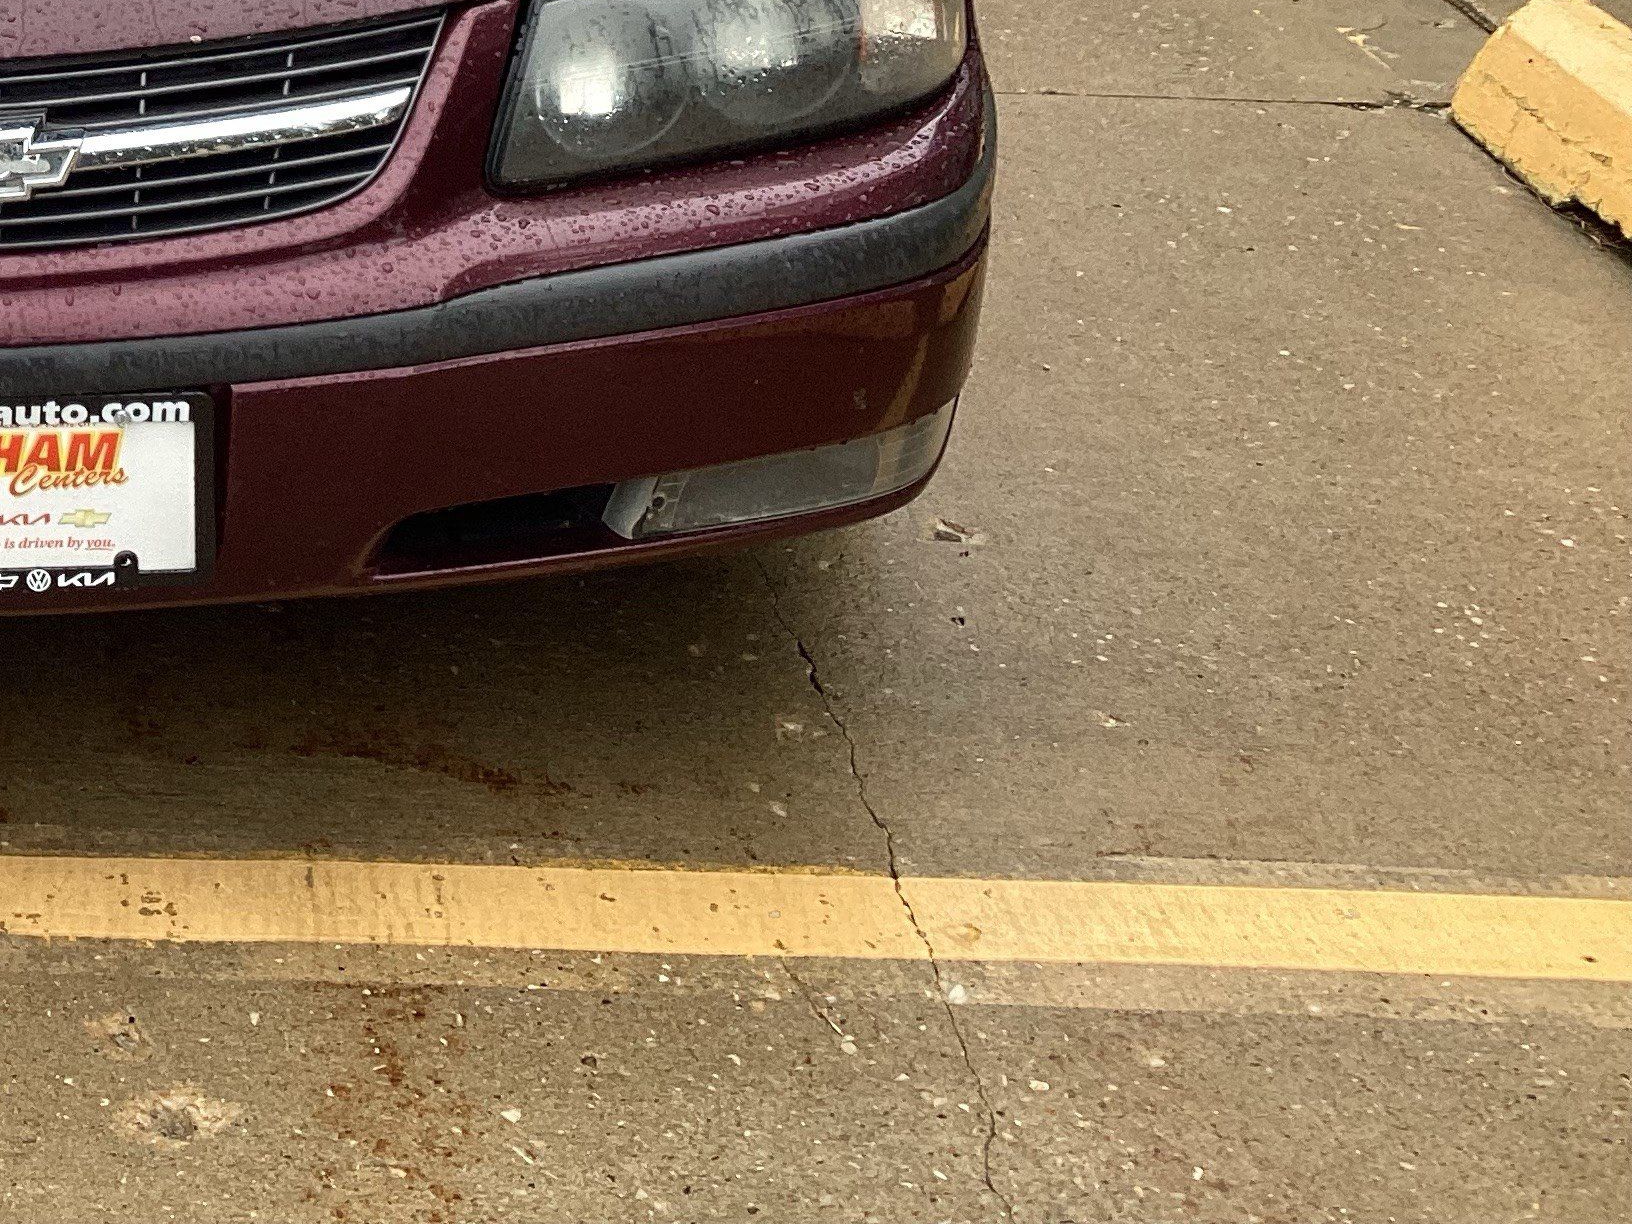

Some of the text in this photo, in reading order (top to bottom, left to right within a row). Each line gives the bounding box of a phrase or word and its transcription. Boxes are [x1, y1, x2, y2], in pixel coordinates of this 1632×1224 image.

[8, 467, 130, 498] Centers
[3, 537, 16, 550] is
[18, 537, 65, 550] driven
[67, 536, 84, 551] by
